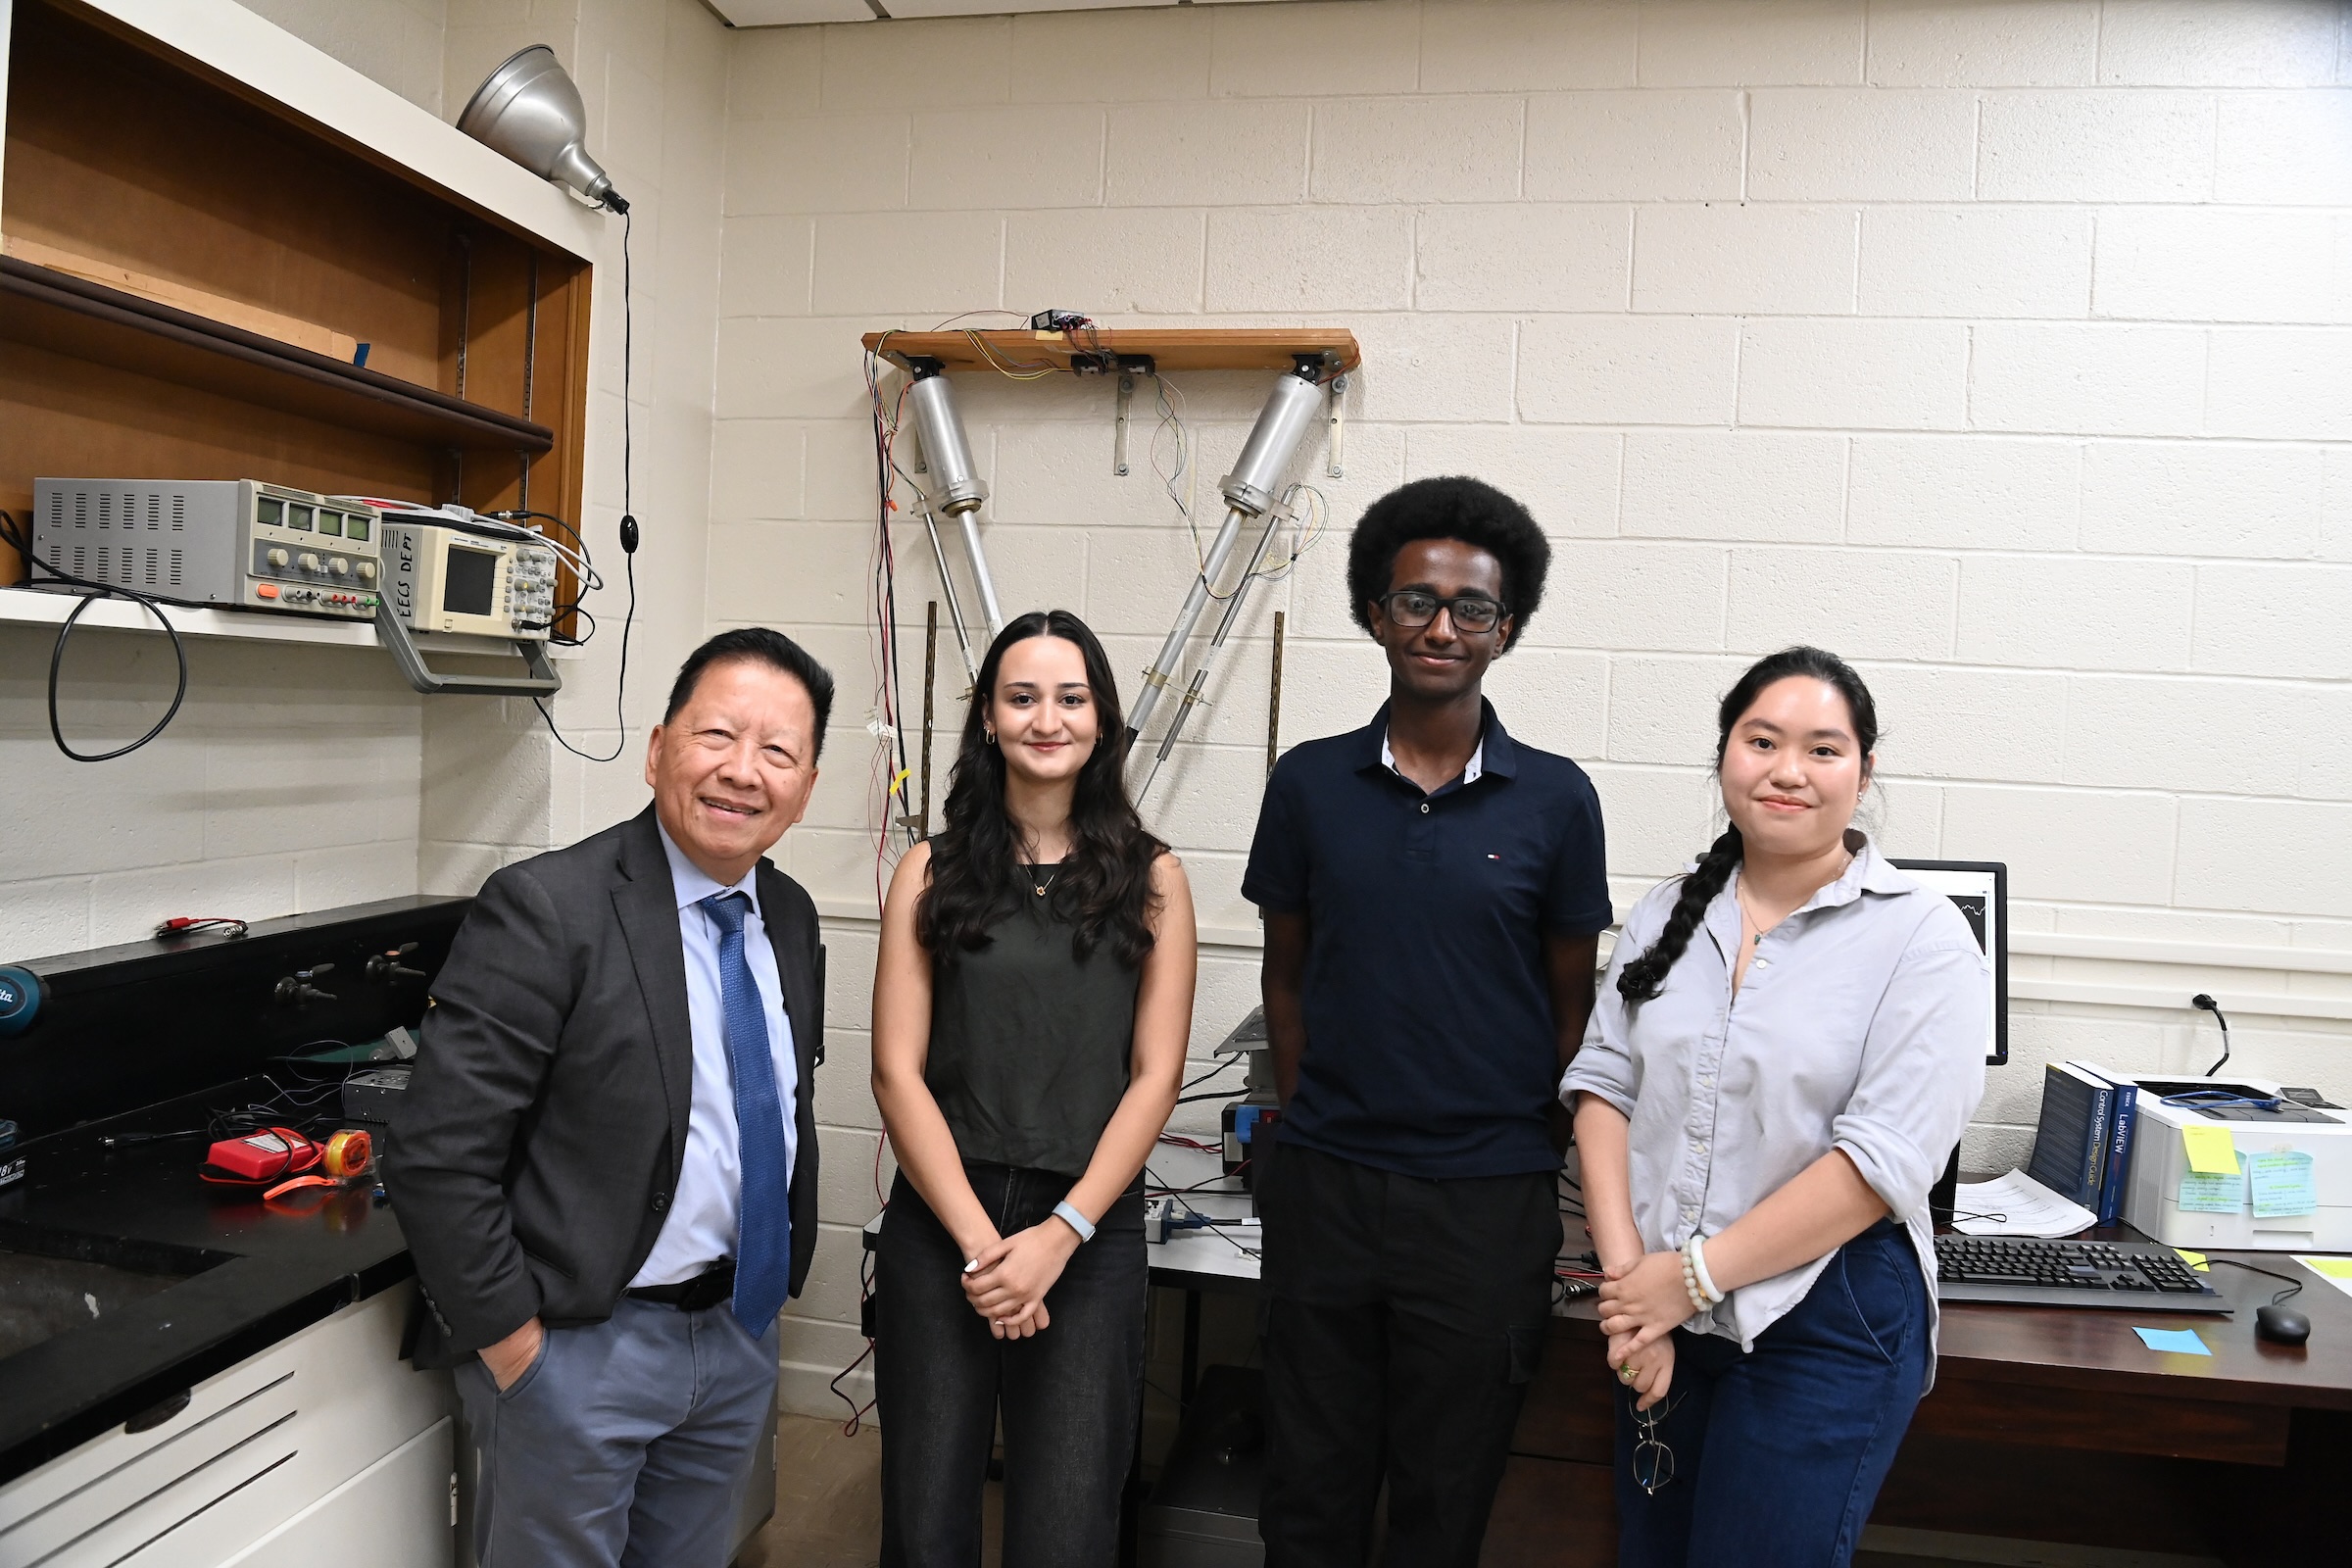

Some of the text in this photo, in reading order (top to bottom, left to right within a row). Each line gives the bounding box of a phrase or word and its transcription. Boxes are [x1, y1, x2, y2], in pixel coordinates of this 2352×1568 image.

[396, 532, 413, 617] EECS DEPT
[2087, 1090, 2108, 1186] Control System Design Guide
[2115, 1113, 2129, 1154] LabVIEW
